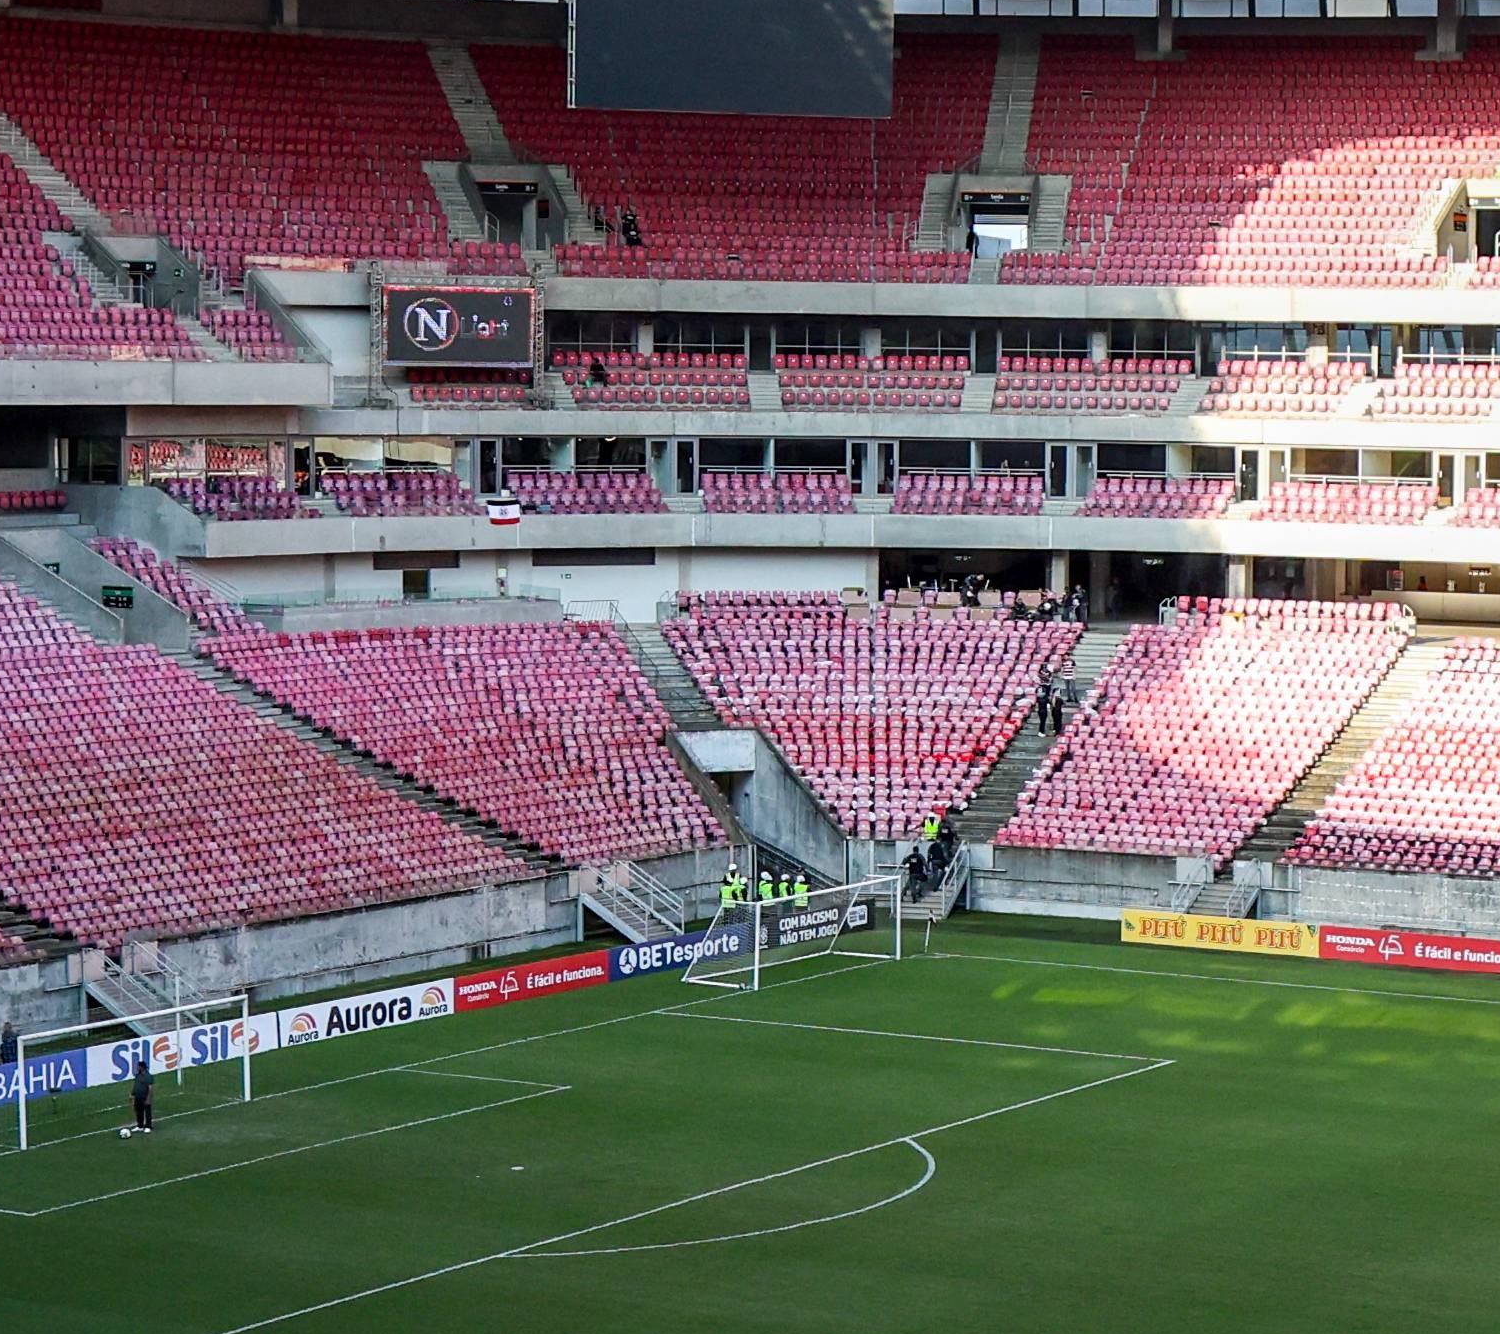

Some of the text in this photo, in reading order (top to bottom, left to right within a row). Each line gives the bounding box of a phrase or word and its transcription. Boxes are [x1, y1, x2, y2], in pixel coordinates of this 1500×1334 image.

[780, 916, 799, 931] COM
[801, 908, 838, 927] RACISMO
[780, 924, 839, 946] NÃO TEM JOGO
[1325, 934, 1375, 947] HONDA
[639, 934, 739, 969] BETesporte
[1414, 942, 1423, 956] É
[1425, 945, 1451, 960] fácil
[1454, 950, 1461, 960] e
[458, 980, 497, 995] HONDA
[526, 965, 605, 989] É fácil e funciona.
[288, 996, 448, 1045] Aurora Aurora Aurora
[111, 1024, 228, 1081] Sil Sil
